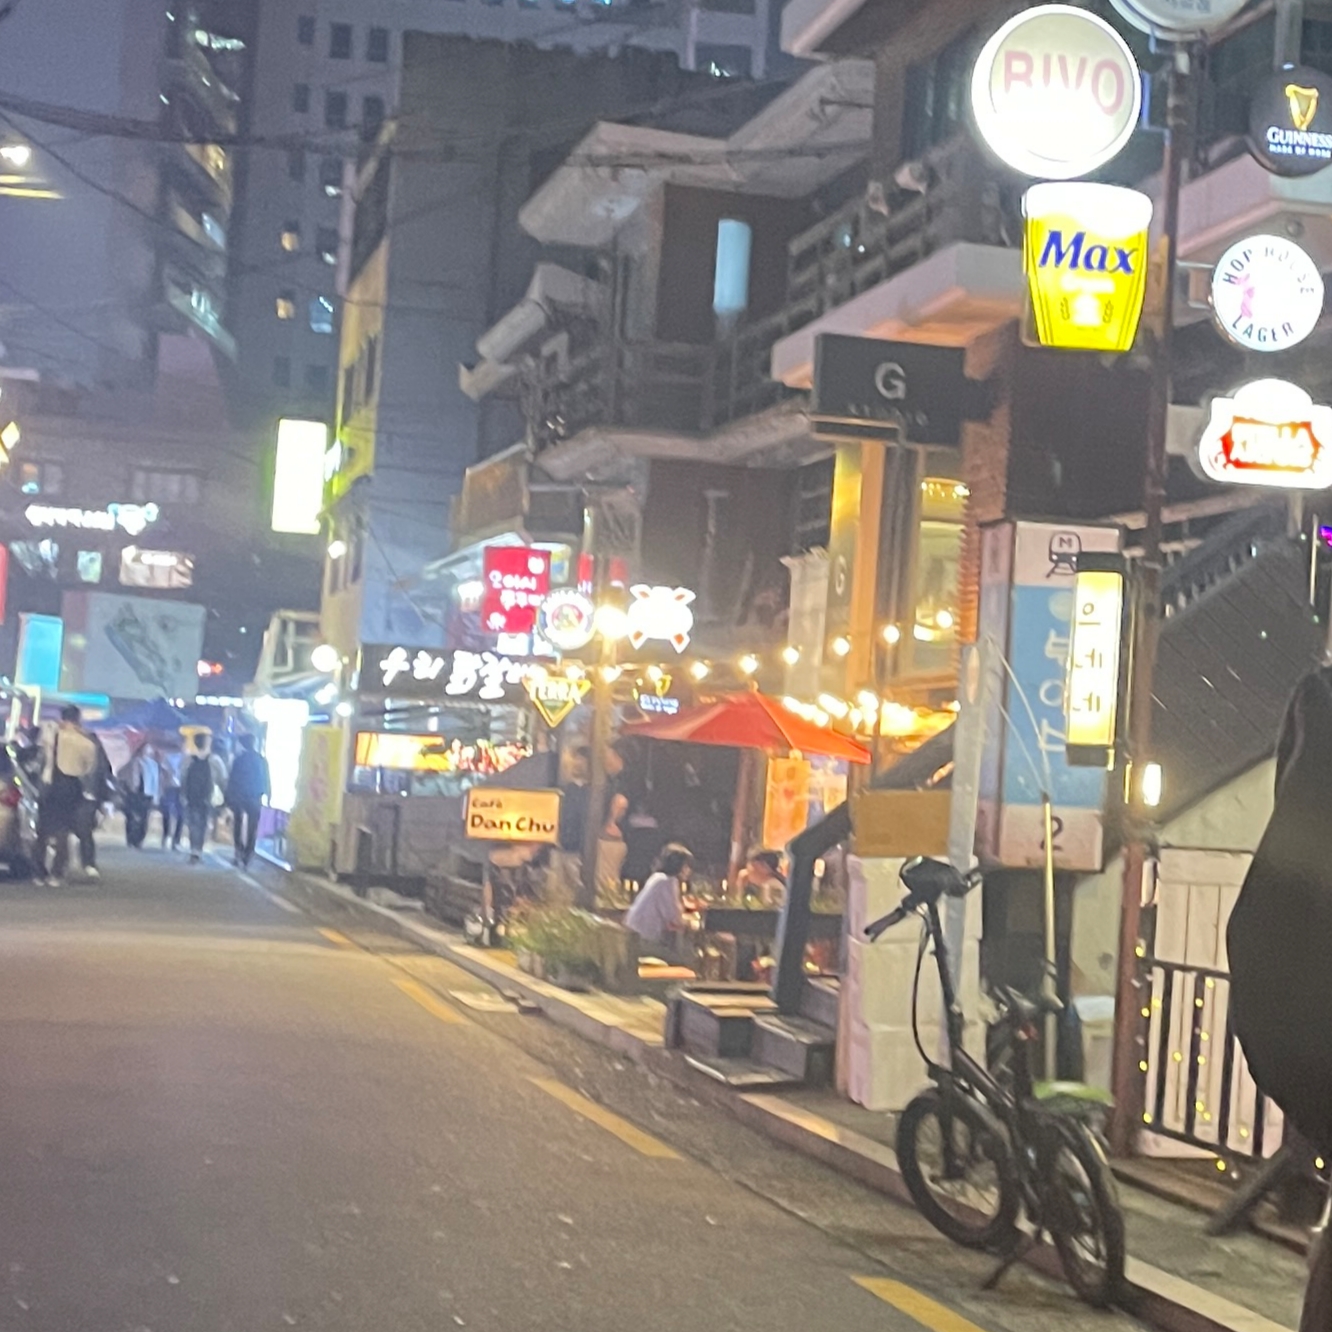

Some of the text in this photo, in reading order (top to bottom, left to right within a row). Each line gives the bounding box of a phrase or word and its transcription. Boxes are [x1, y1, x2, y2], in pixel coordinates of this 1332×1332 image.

[1038, 230, 1139, 274] Max
[874, 362, 907, 399] G
[470, 813, 555, 833] Dan Chu
